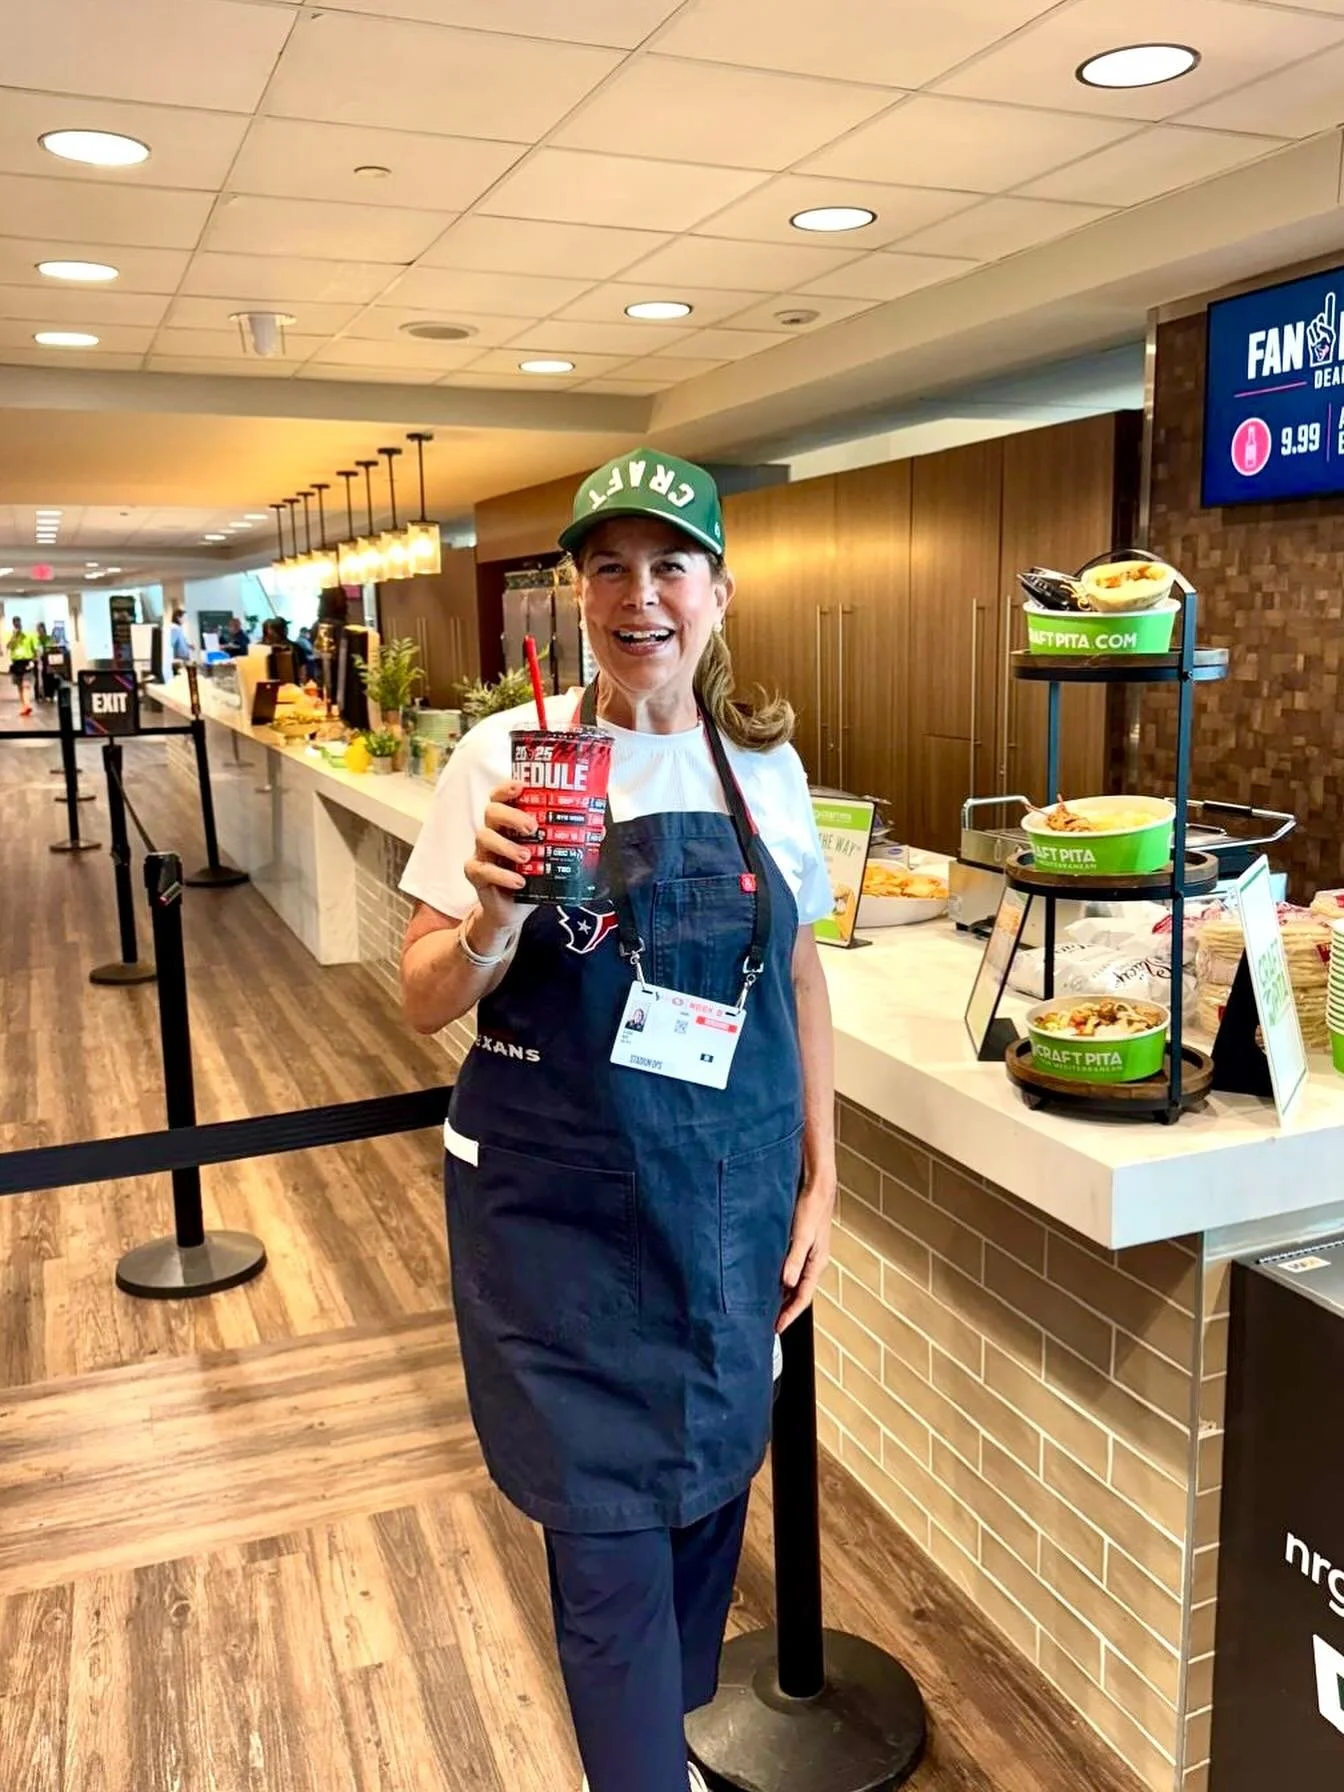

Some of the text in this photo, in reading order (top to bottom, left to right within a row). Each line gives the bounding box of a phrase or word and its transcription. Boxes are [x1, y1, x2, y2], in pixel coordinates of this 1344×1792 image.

[1247, 320, 1305, 380] FAN
[1280, 422, 1320, 456] 9.99
[588, 460, 695, 510] CRAFT
[91, 692, 128, 714] EXIT
[1059, 848, 1096, 863] PITA
[1084, 1051, 1123, 1066] PITA
